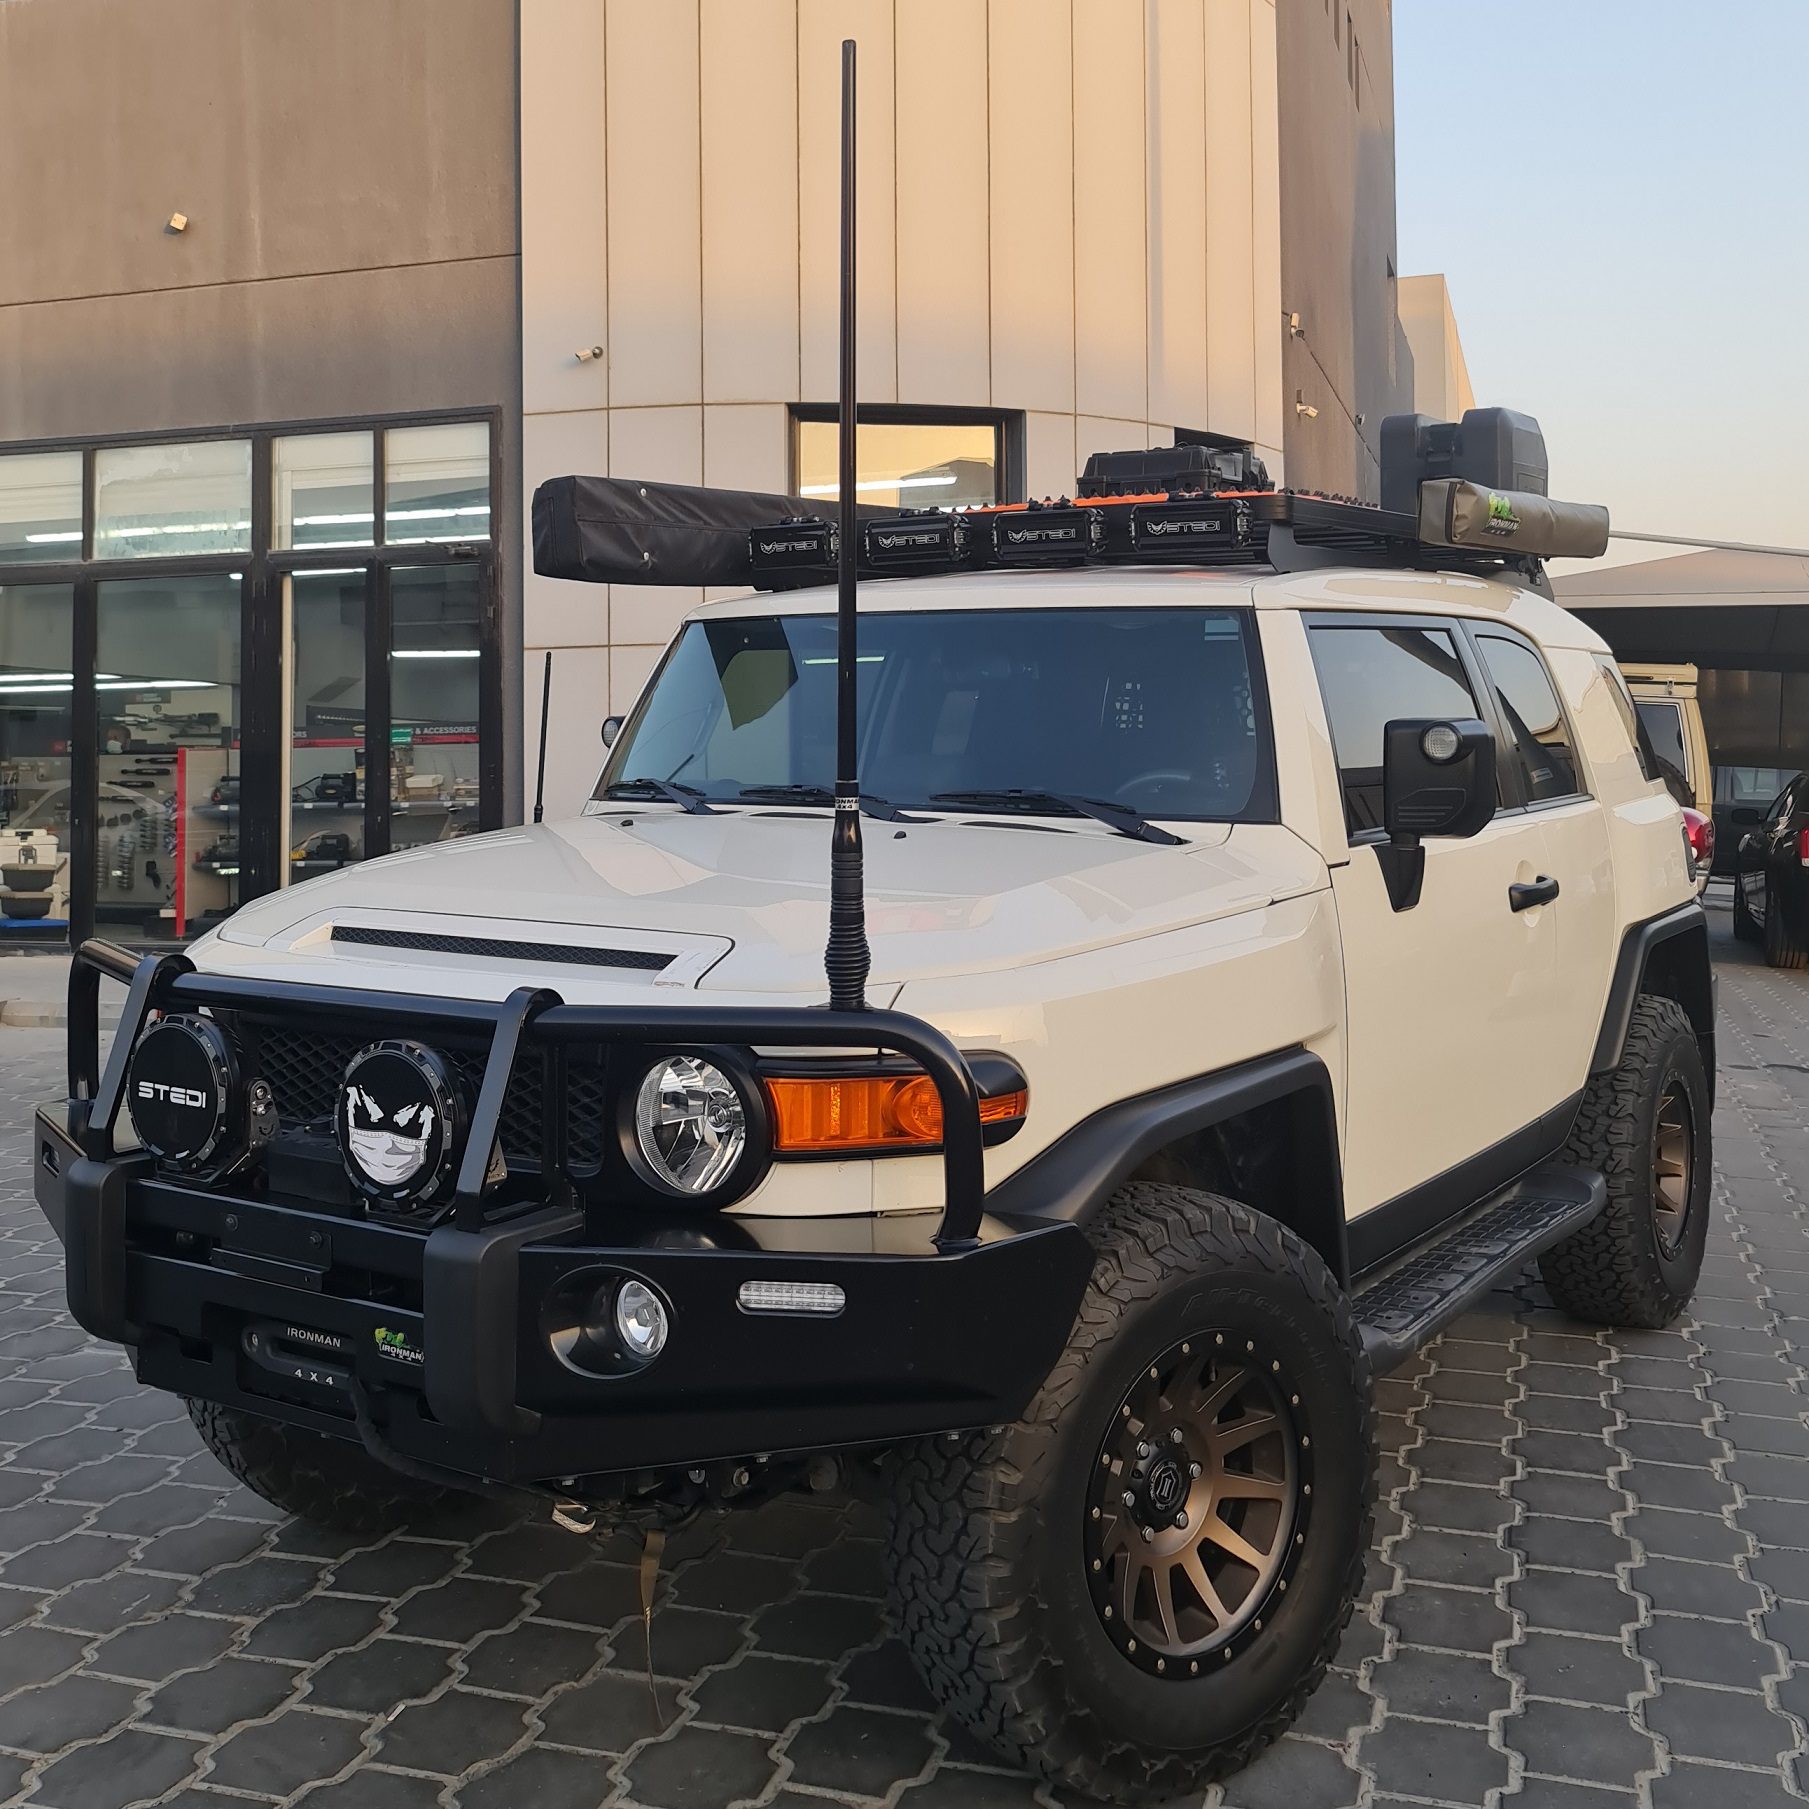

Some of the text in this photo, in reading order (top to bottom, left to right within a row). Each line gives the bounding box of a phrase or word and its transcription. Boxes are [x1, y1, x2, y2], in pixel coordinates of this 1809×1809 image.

[1166, 520, 1221, 533] STEDI
[893, 533, 940, 545] STEDI
[1026, 528, 1076, 541] STEDI
[775, 540, 818, 552] STEDI
[423, 726, 477, 735] ACCESSORIES
[138, 1081, 207, 1109] STEDI
[287, 1326, 341, 1348] IRONMAN
[382, 1343, 423, 1361] IRONMAN
